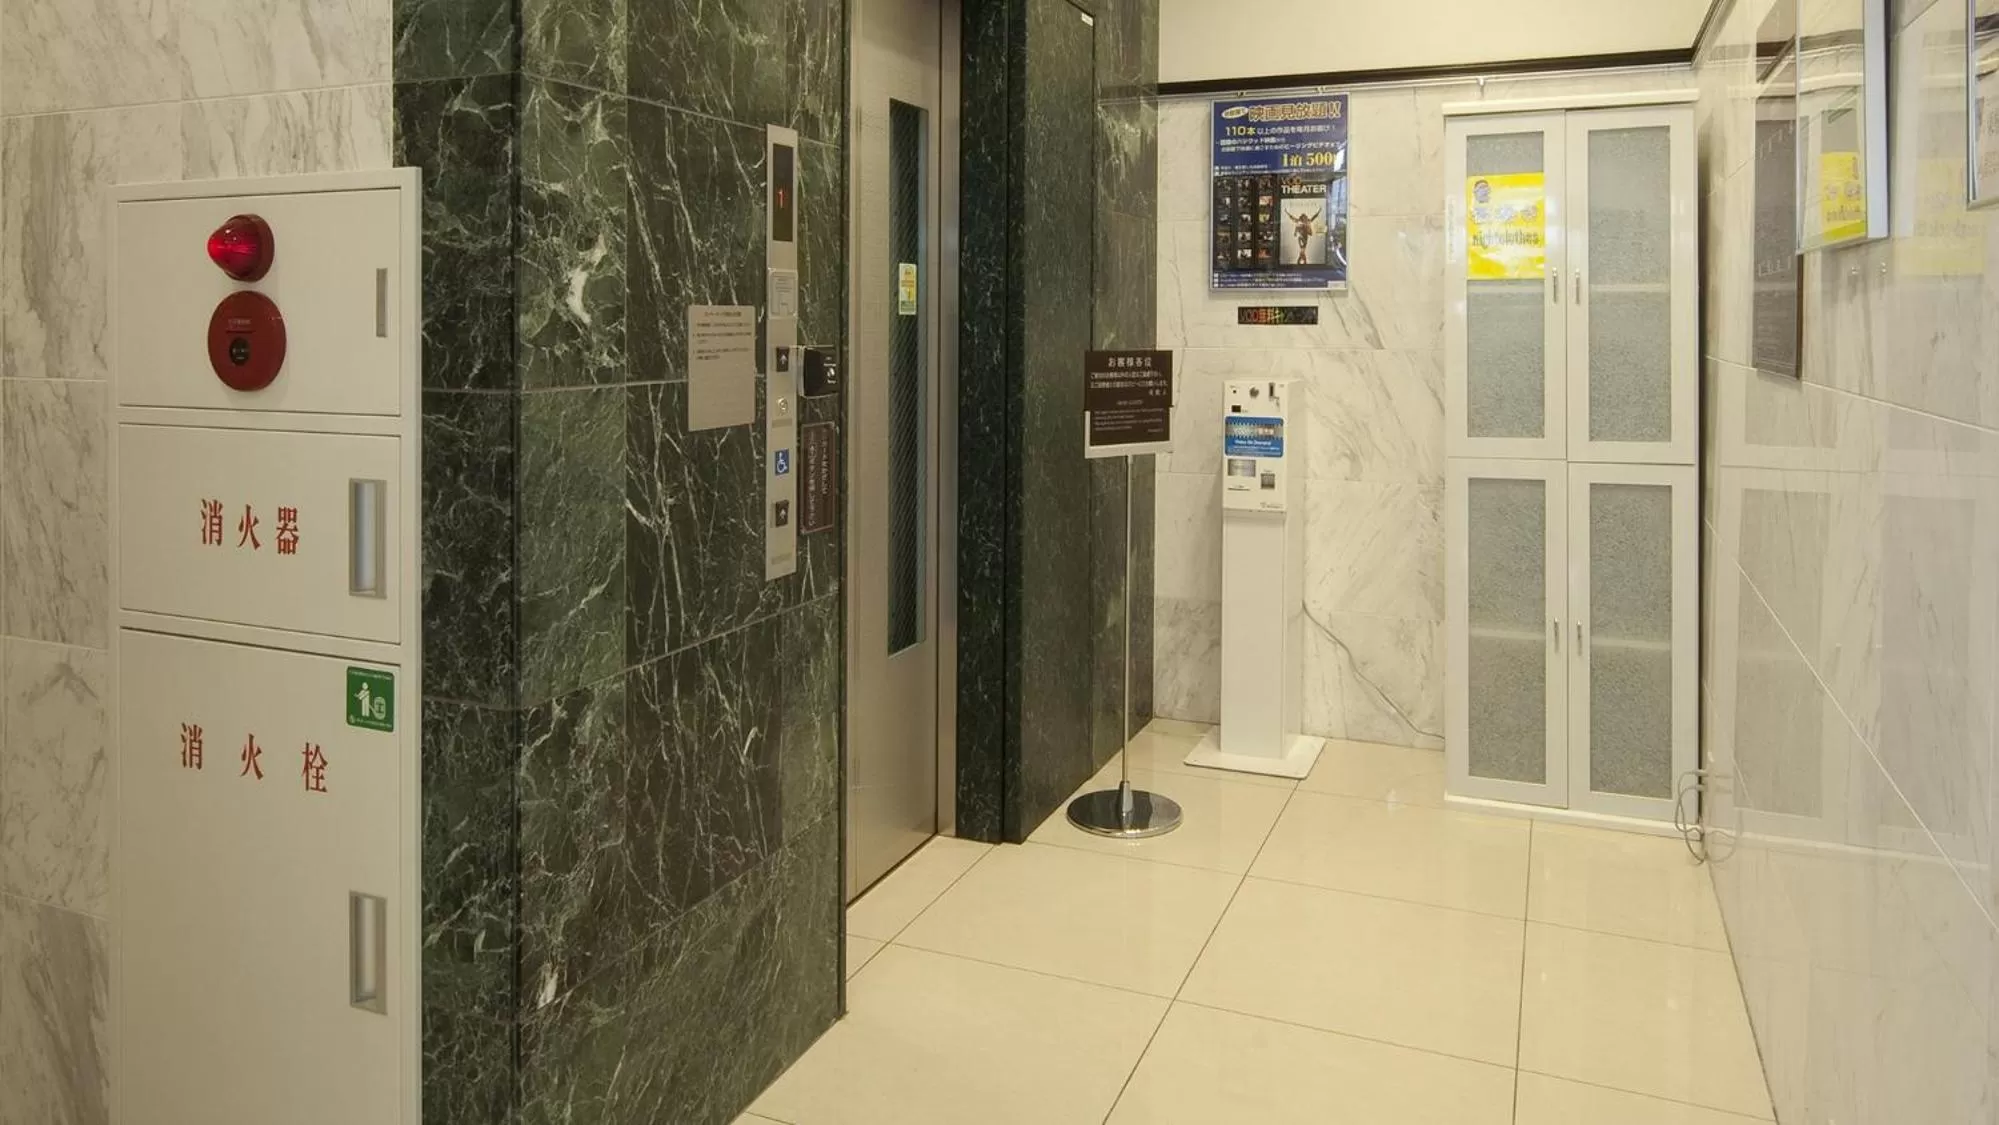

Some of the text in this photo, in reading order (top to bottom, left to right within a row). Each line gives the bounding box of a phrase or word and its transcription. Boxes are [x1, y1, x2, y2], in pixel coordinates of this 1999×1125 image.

[778, 189, 785, 209] 1
[1281, 184, 1327, 194] THEATER
[201, 498, 299, 555] 消火器
[180, 722, 328, 793] 消火栓
